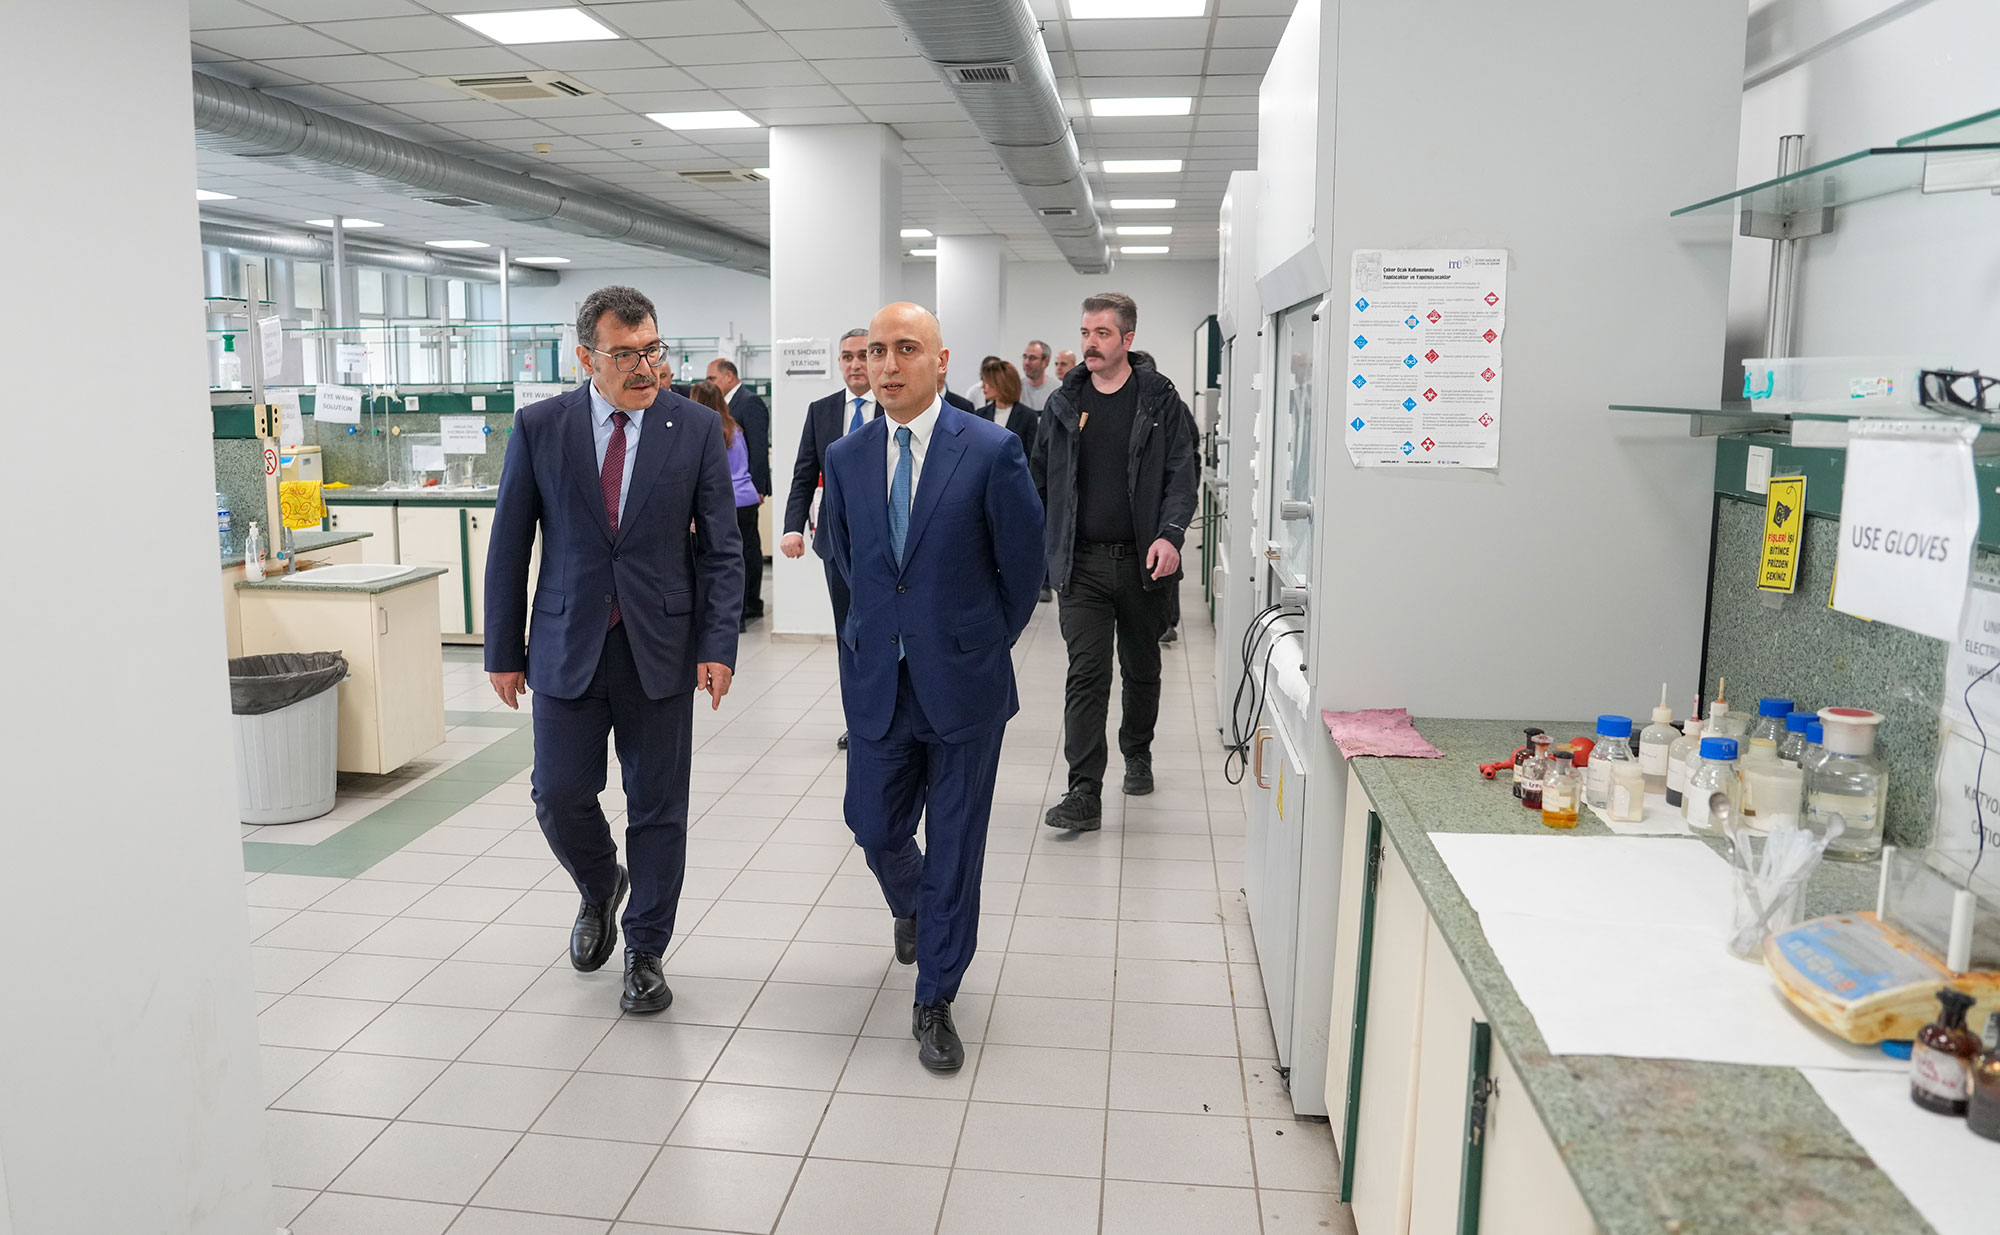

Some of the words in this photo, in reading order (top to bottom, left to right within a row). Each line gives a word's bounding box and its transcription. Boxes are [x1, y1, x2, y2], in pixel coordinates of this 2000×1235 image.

[322, 403, 353, 412] SOLUTION
[1852, 525, 1882, 551] USE
[1884, 530, 1950, 562] GLOVES
[1965, 784, 2000, 816] KATYO
